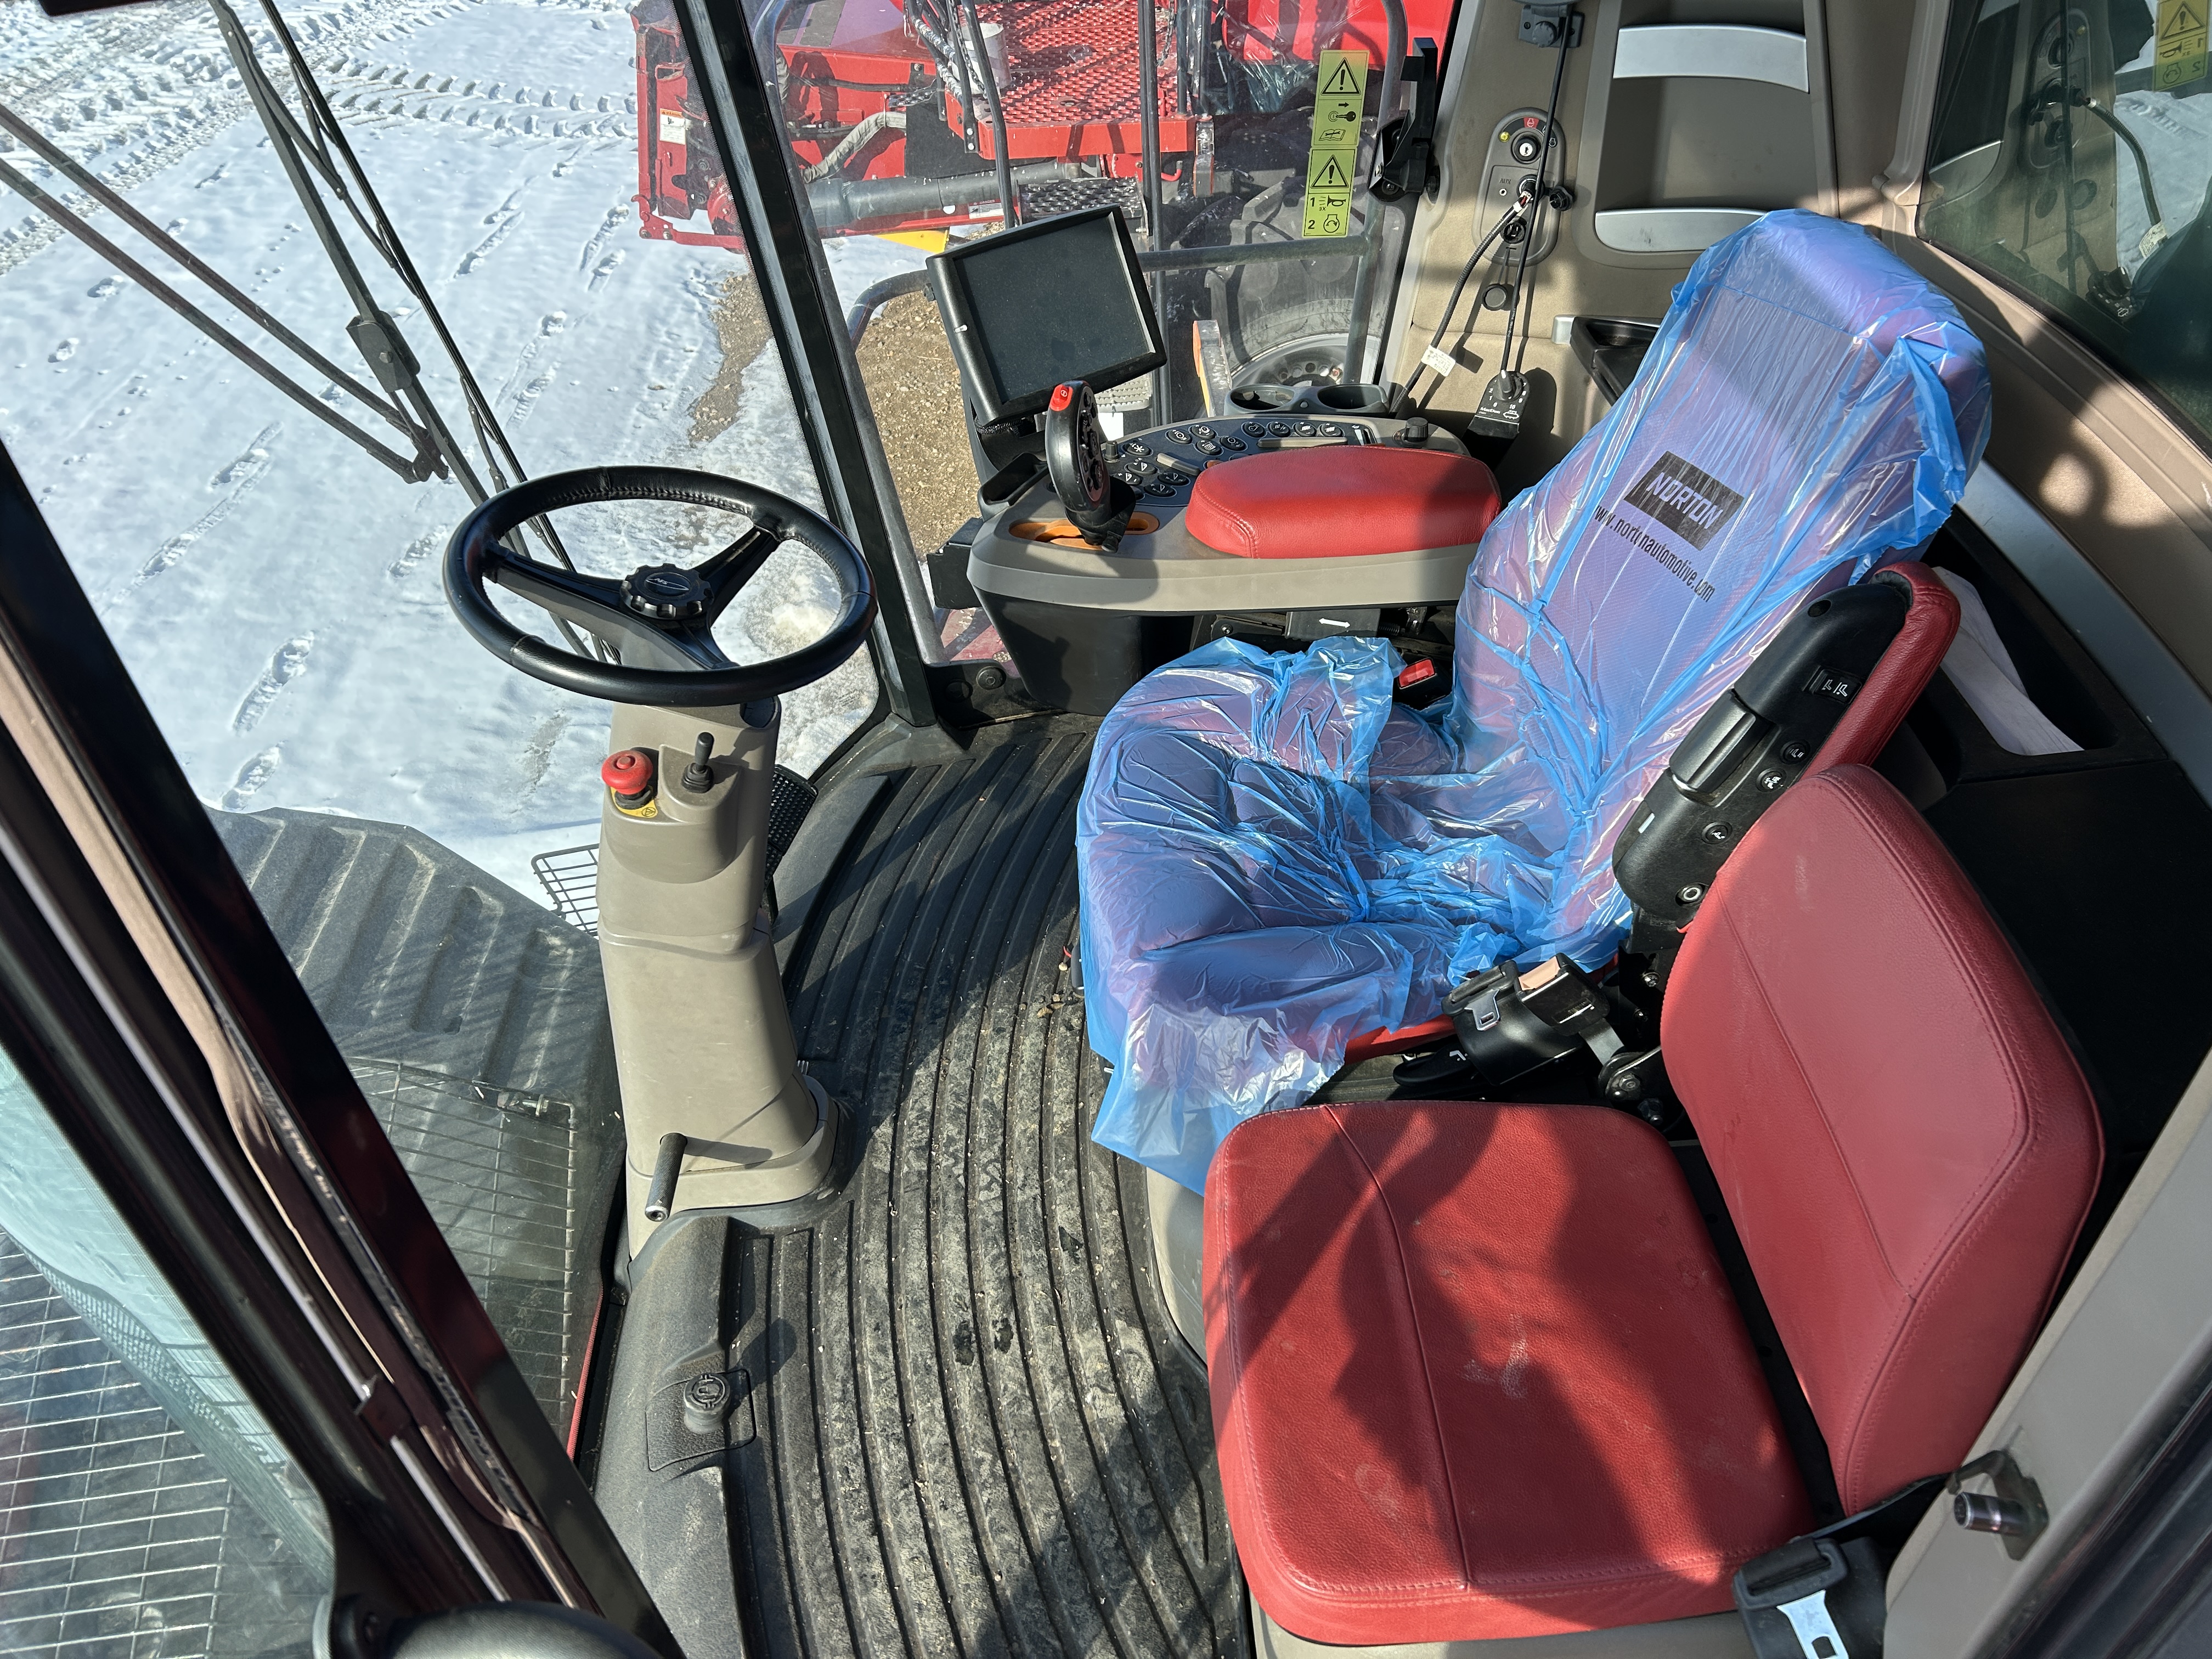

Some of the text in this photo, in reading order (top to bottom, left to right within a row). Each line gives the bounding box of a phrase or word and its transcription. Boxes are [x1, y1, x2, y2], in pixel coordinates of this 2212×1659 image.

[1310, 197, 1315, 207] 1
[1308, 219, 1316, 229] 2
[1646, 472, 1724, 530] NORTON
